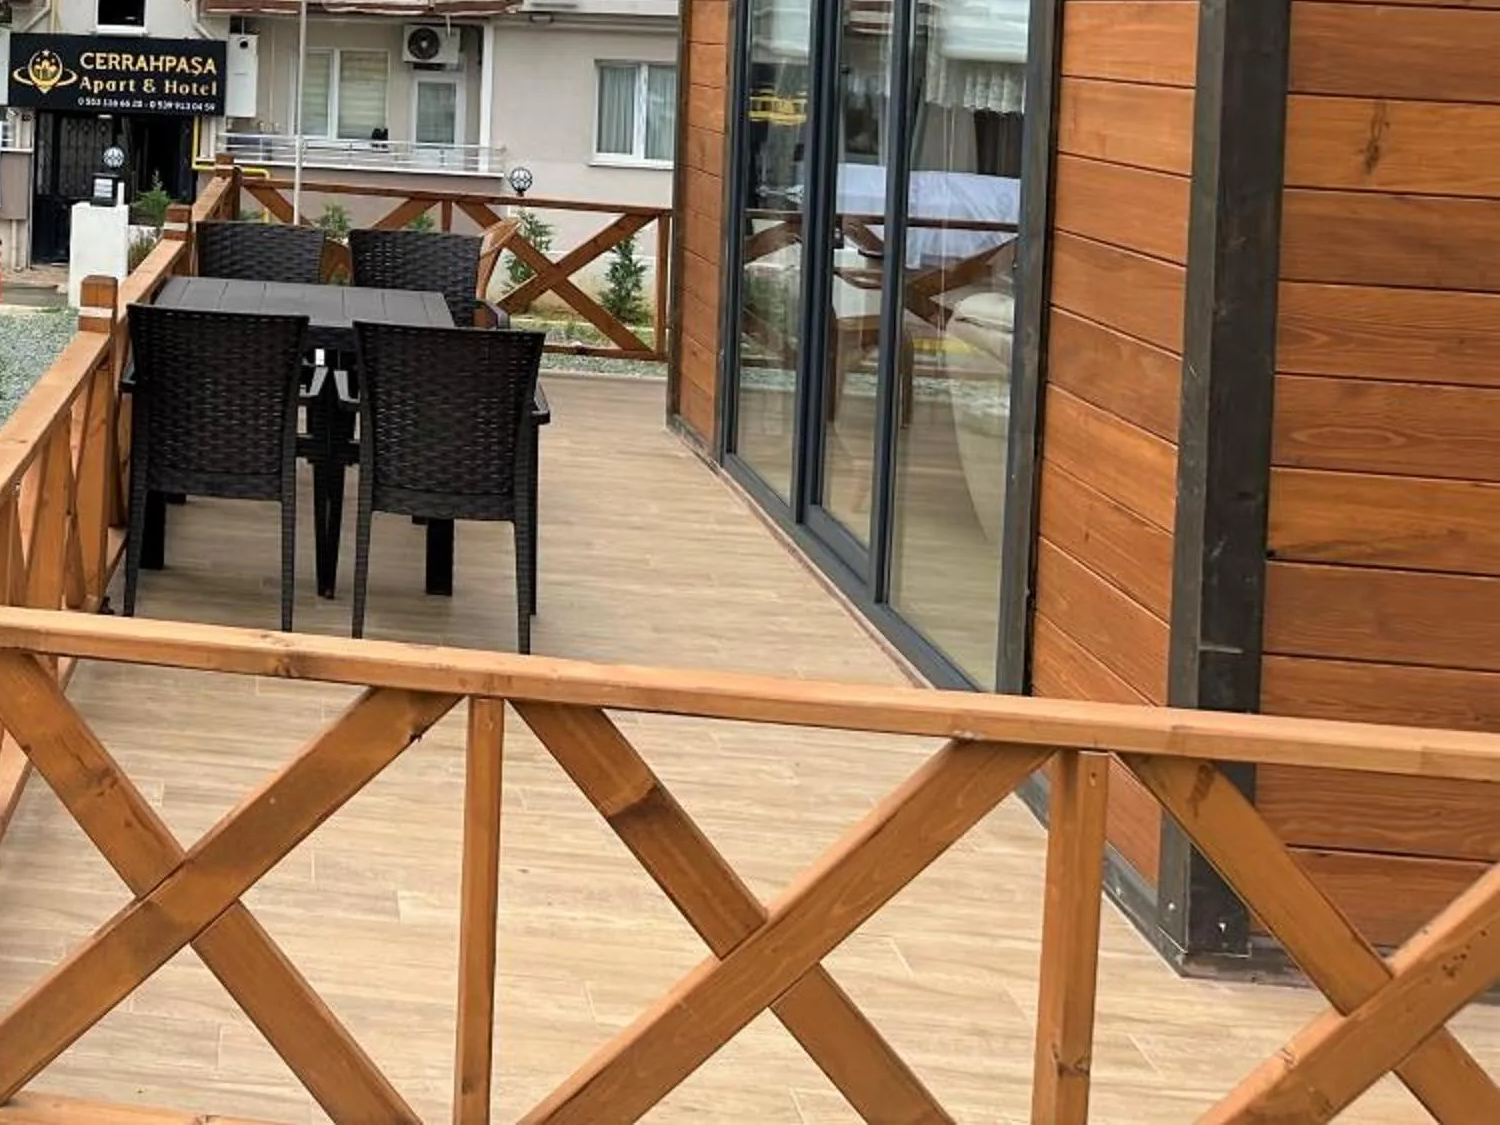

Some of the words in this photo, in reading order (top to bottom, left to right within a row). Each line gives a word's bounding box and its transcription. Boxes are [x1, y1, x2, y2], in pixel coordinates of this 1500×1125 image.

[80, 52, 217, 75] CERRAHPAŞA
[79, 76, 136, 94] Apart
[143, 77, 157, 93] &
[164, 80, 217, 96] Hotel
